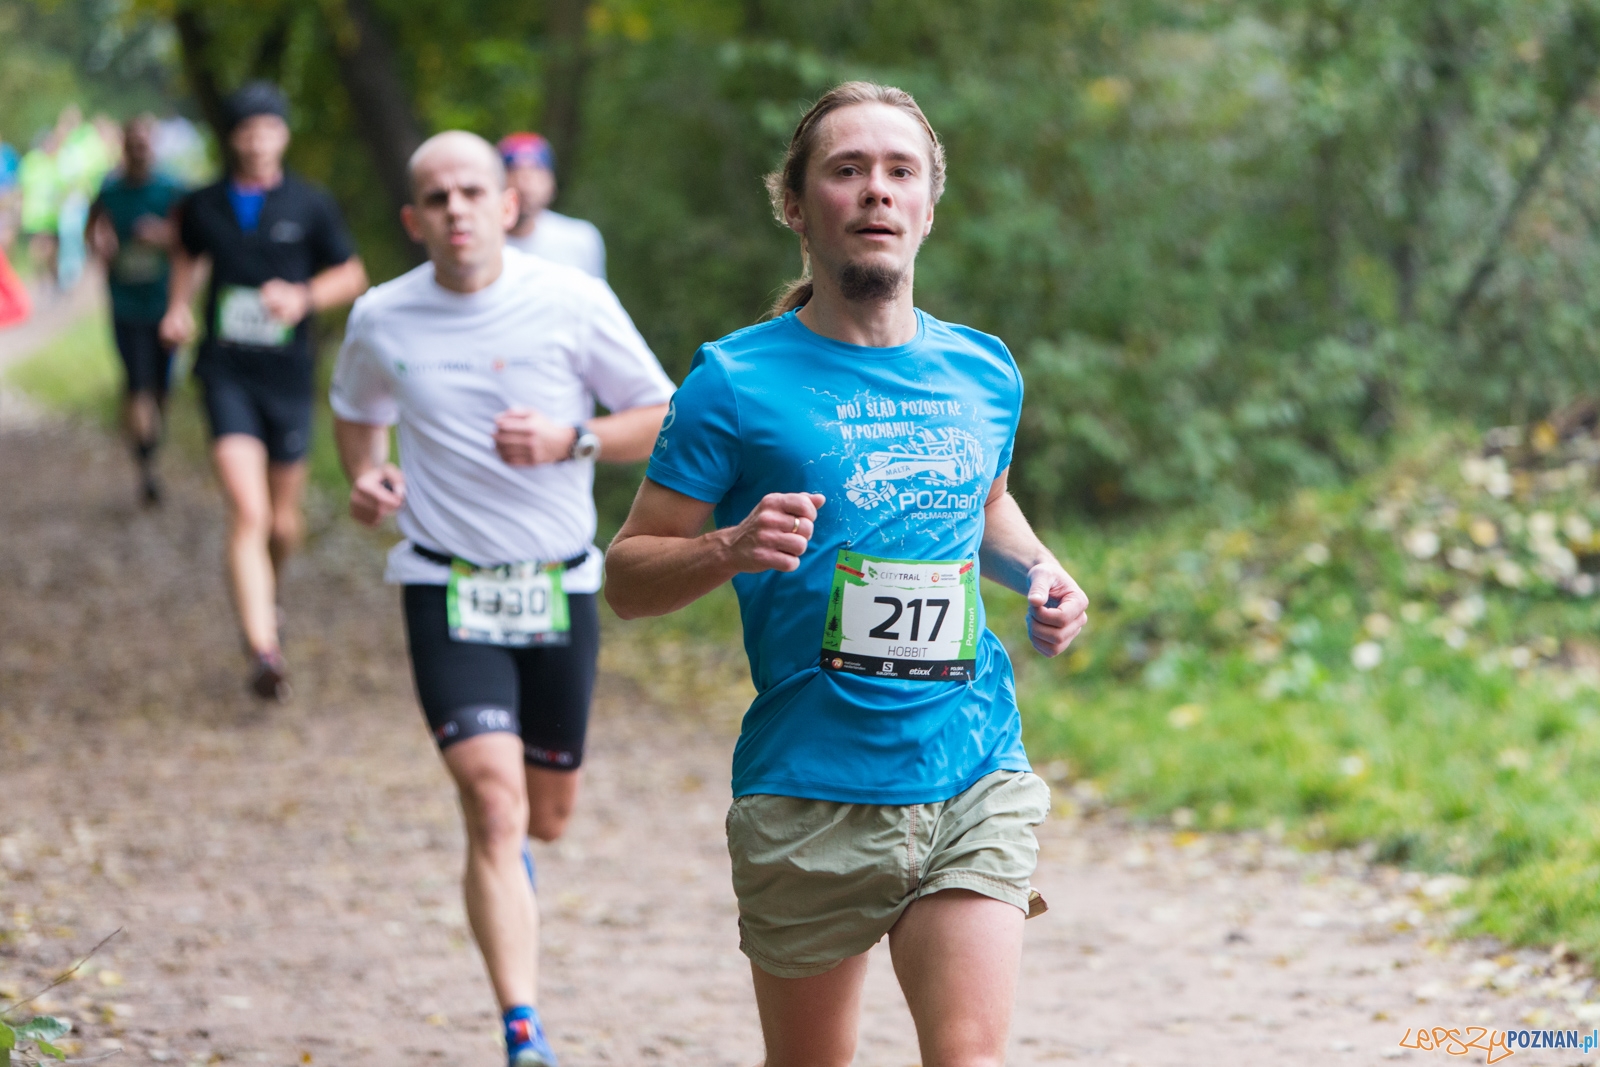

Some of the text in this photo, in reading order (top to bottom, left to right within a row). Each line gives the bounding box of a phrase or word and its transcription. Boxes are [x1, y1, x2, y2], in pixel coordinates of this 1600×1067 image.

[901, 400, 962, 416] POZOSTAŁ
[840, 422, 915, 439] W POZNANIU
[885, 465, 911, 476] MALTA
[911, 511, 968, 520] PÓŁMARATON
[869, 596, 951, 641] 217
[966, 607, 974, 646] Poznań
[887, 646, 928, 658] HOBBIT
